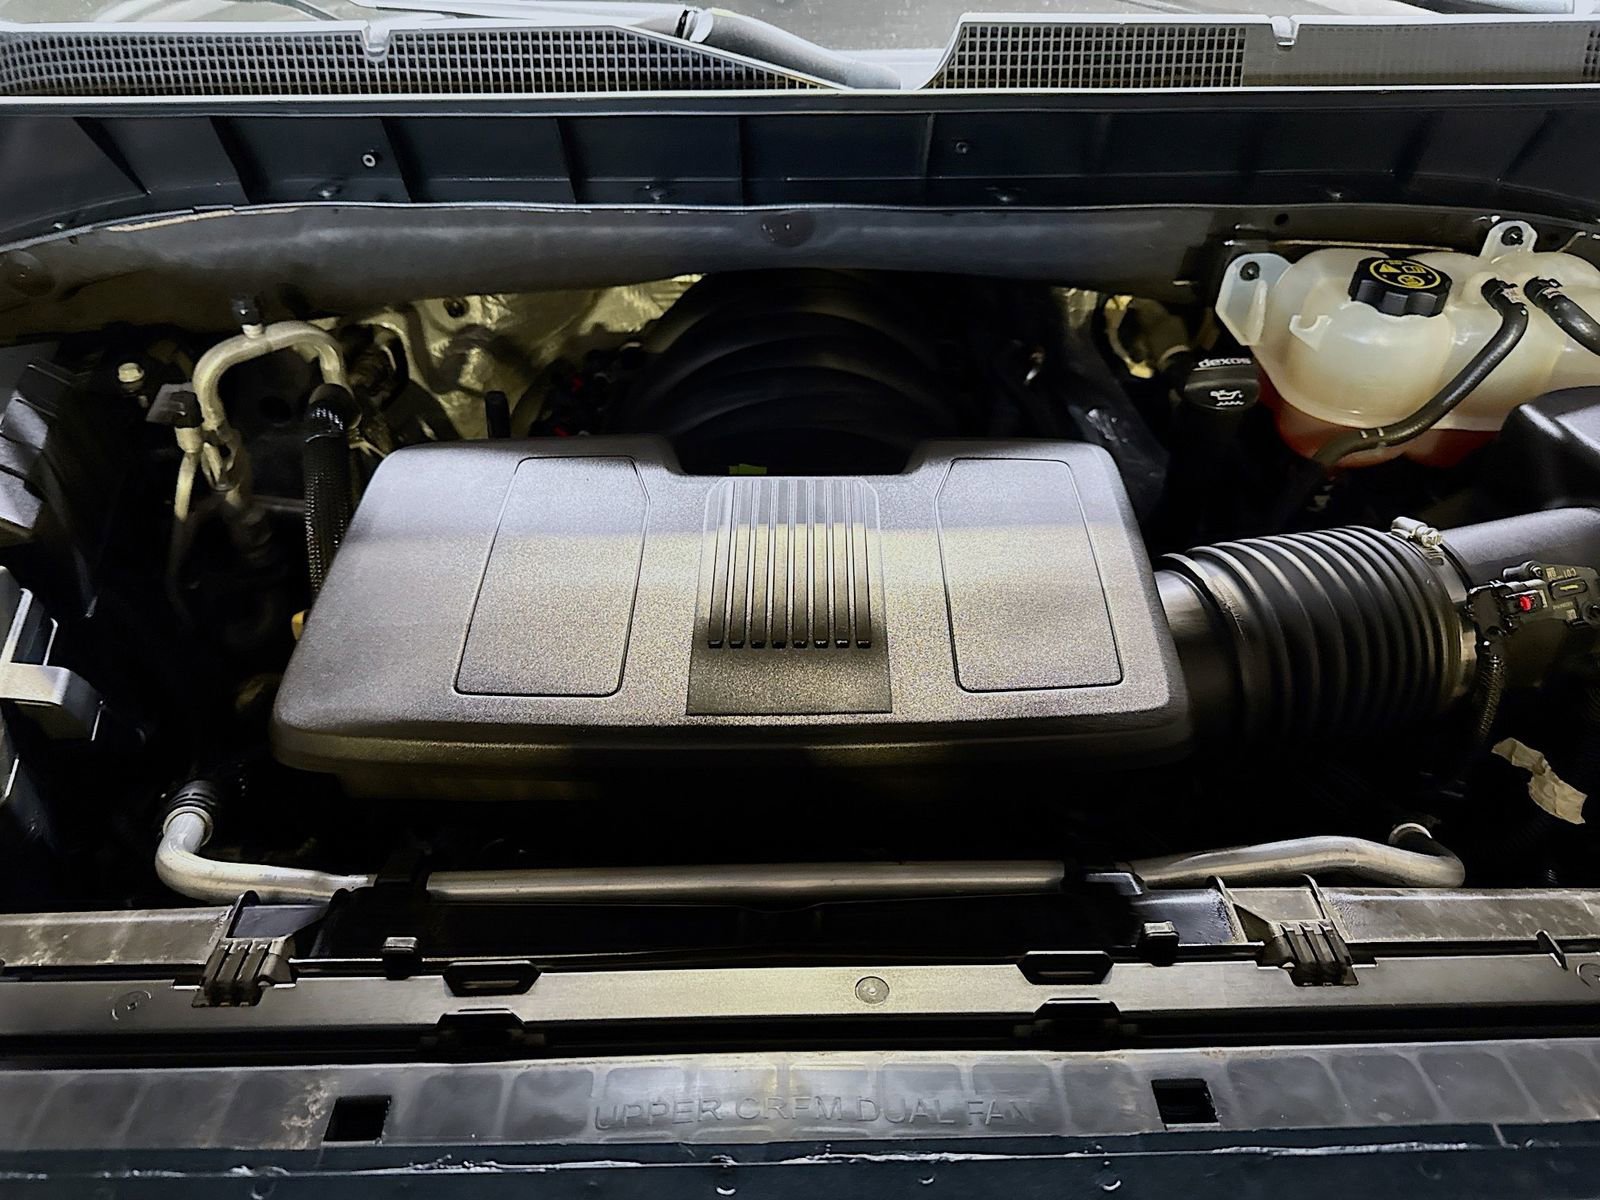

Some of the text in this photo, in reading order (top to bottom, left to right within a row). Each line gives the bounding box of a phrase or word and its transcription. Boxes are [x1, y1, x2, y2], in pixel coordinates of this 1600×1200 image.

[595, 1096, 1035, 1131] UPPER CRFM DUAL FAN
